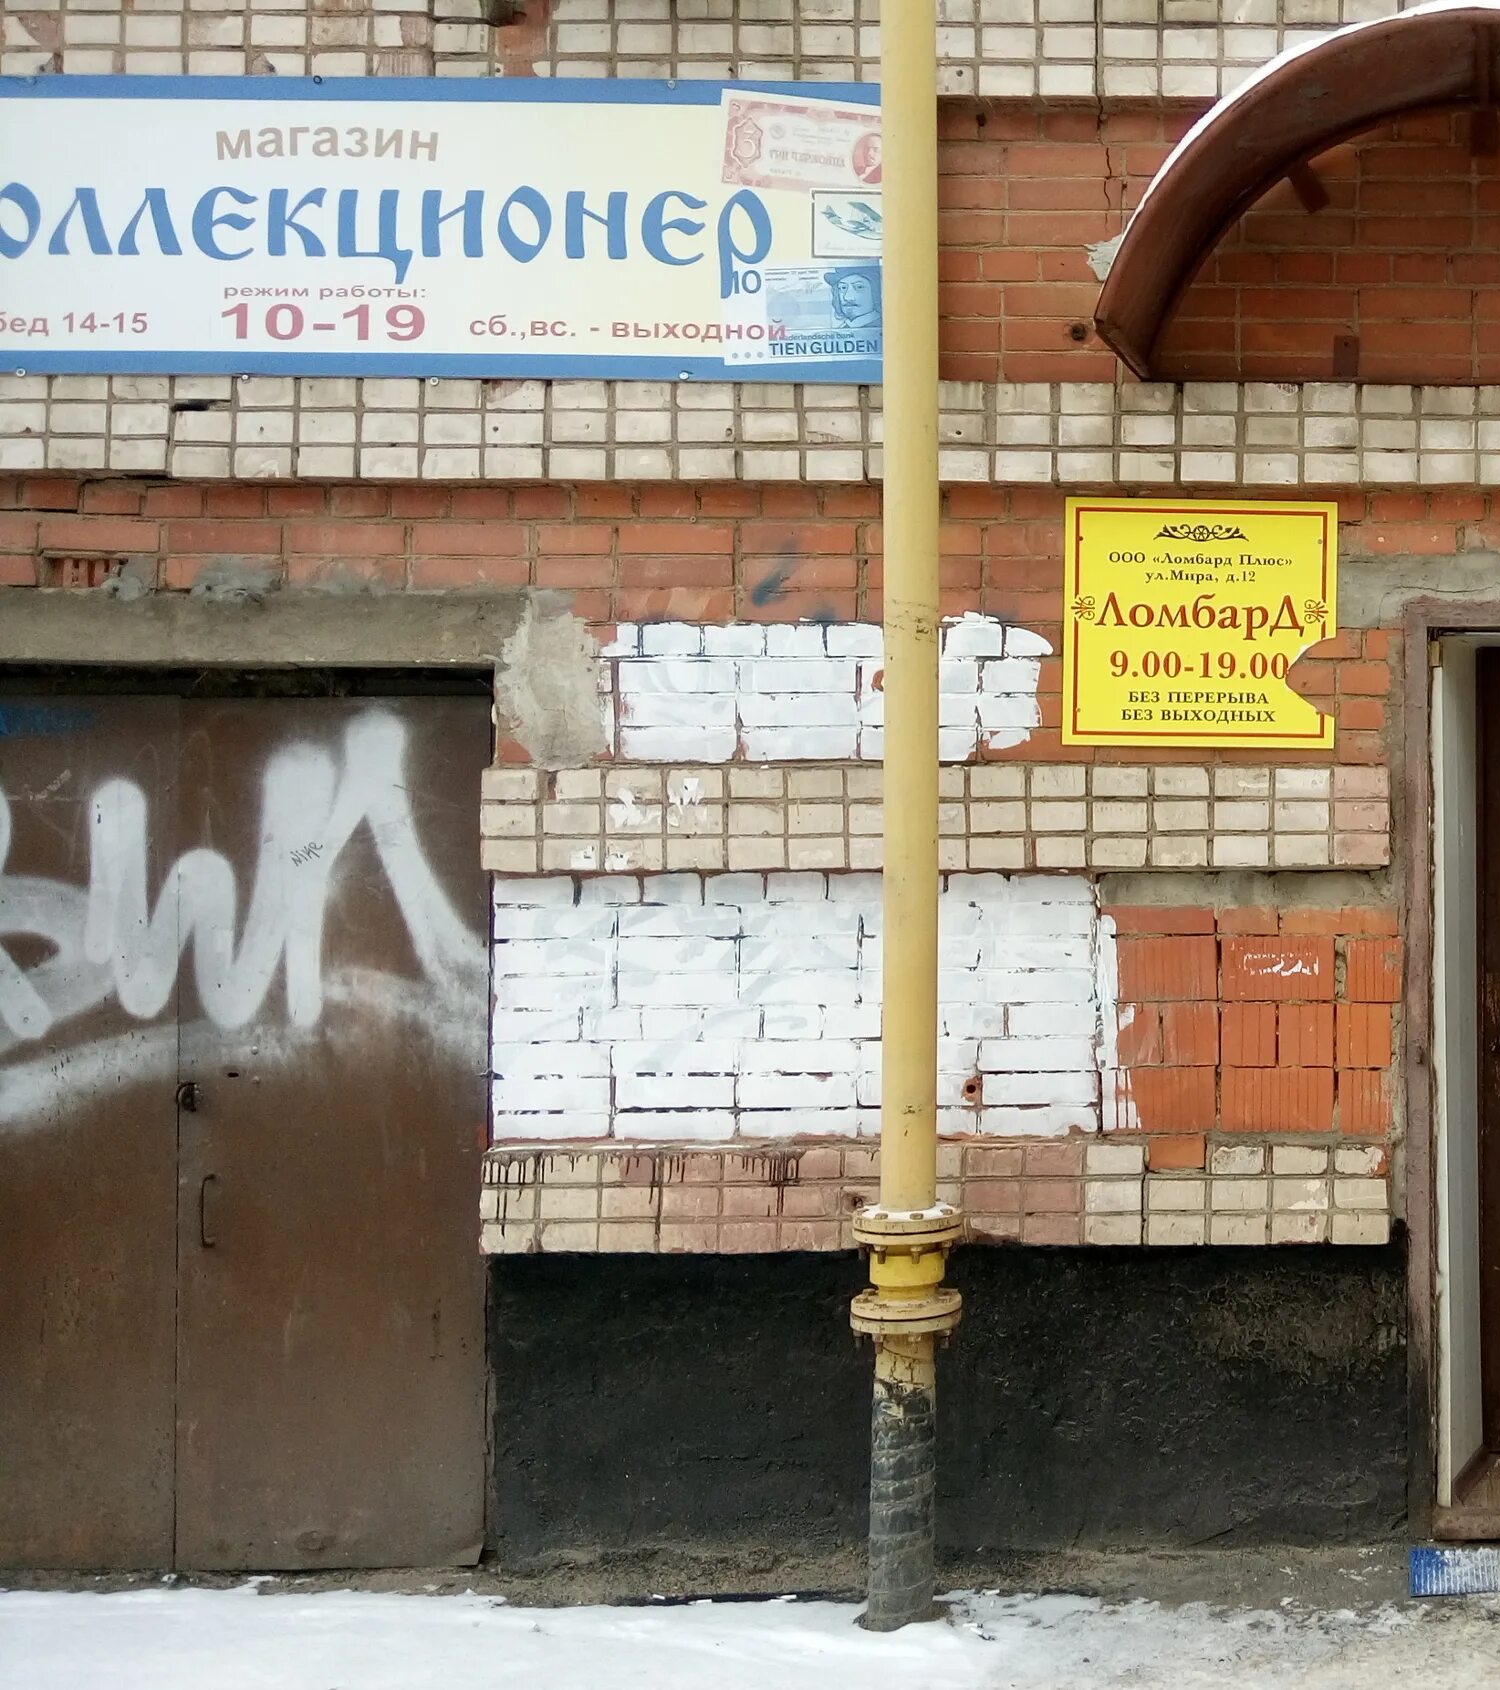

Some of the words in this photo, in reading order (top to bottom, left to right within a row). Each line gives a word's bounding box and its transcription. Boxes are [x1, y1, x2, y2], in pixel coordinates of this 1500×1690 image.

[216, 126, 439, 162] магазин
[733, 270, 762, 295] 10
[223, 286, 309, 299] режим
[319, 285, 426, 300] работы:
[62, 312, 148, 334] 14-15
[221, 303, 426, 341] 10-19
[611, 317, 786, 343] выходной
[769, 342, 807, 356] TIEN
[810, 340, 879, 354] GULDEN
[1109, 552, 1145, 564] ООО
[1153, 553, 1232, 568] «Ломбард
[1239, 554, 1292, 568] Плюс»
[1226, 571, 1256, 583] д.12
[1110, 650, 1289, 680] 9.00-19.00
[1128, 691, 1160, 703] БЕЗ
[1168, 692, 1269, 705] ПЕРЕРЫВА
[1121, 709, 1153, 721] БЕЗ
[1161, 710, 1276, 725] ВЫХОДНЫХ
